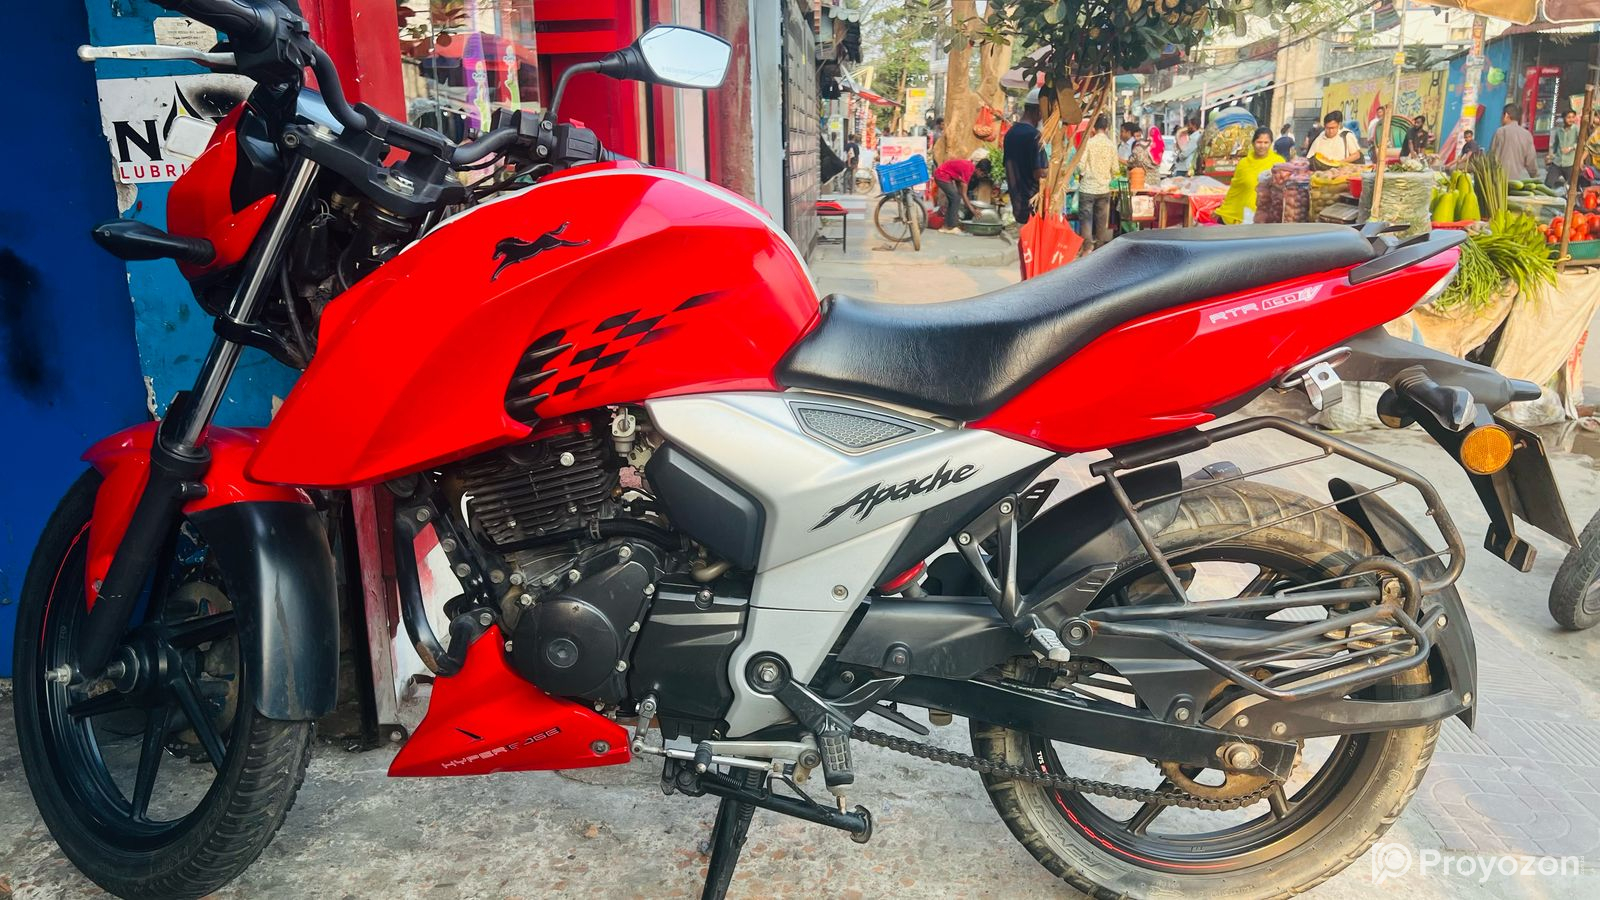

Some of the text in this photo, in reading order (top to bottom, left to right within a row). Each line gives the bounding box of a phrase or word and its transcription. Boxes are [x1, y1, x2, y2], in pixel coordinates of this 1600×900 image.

[1208, 302, 1259, 324] RTR
[810, 459, 980, 531] Apache
[1036, 750, 1045, 765] TVS
